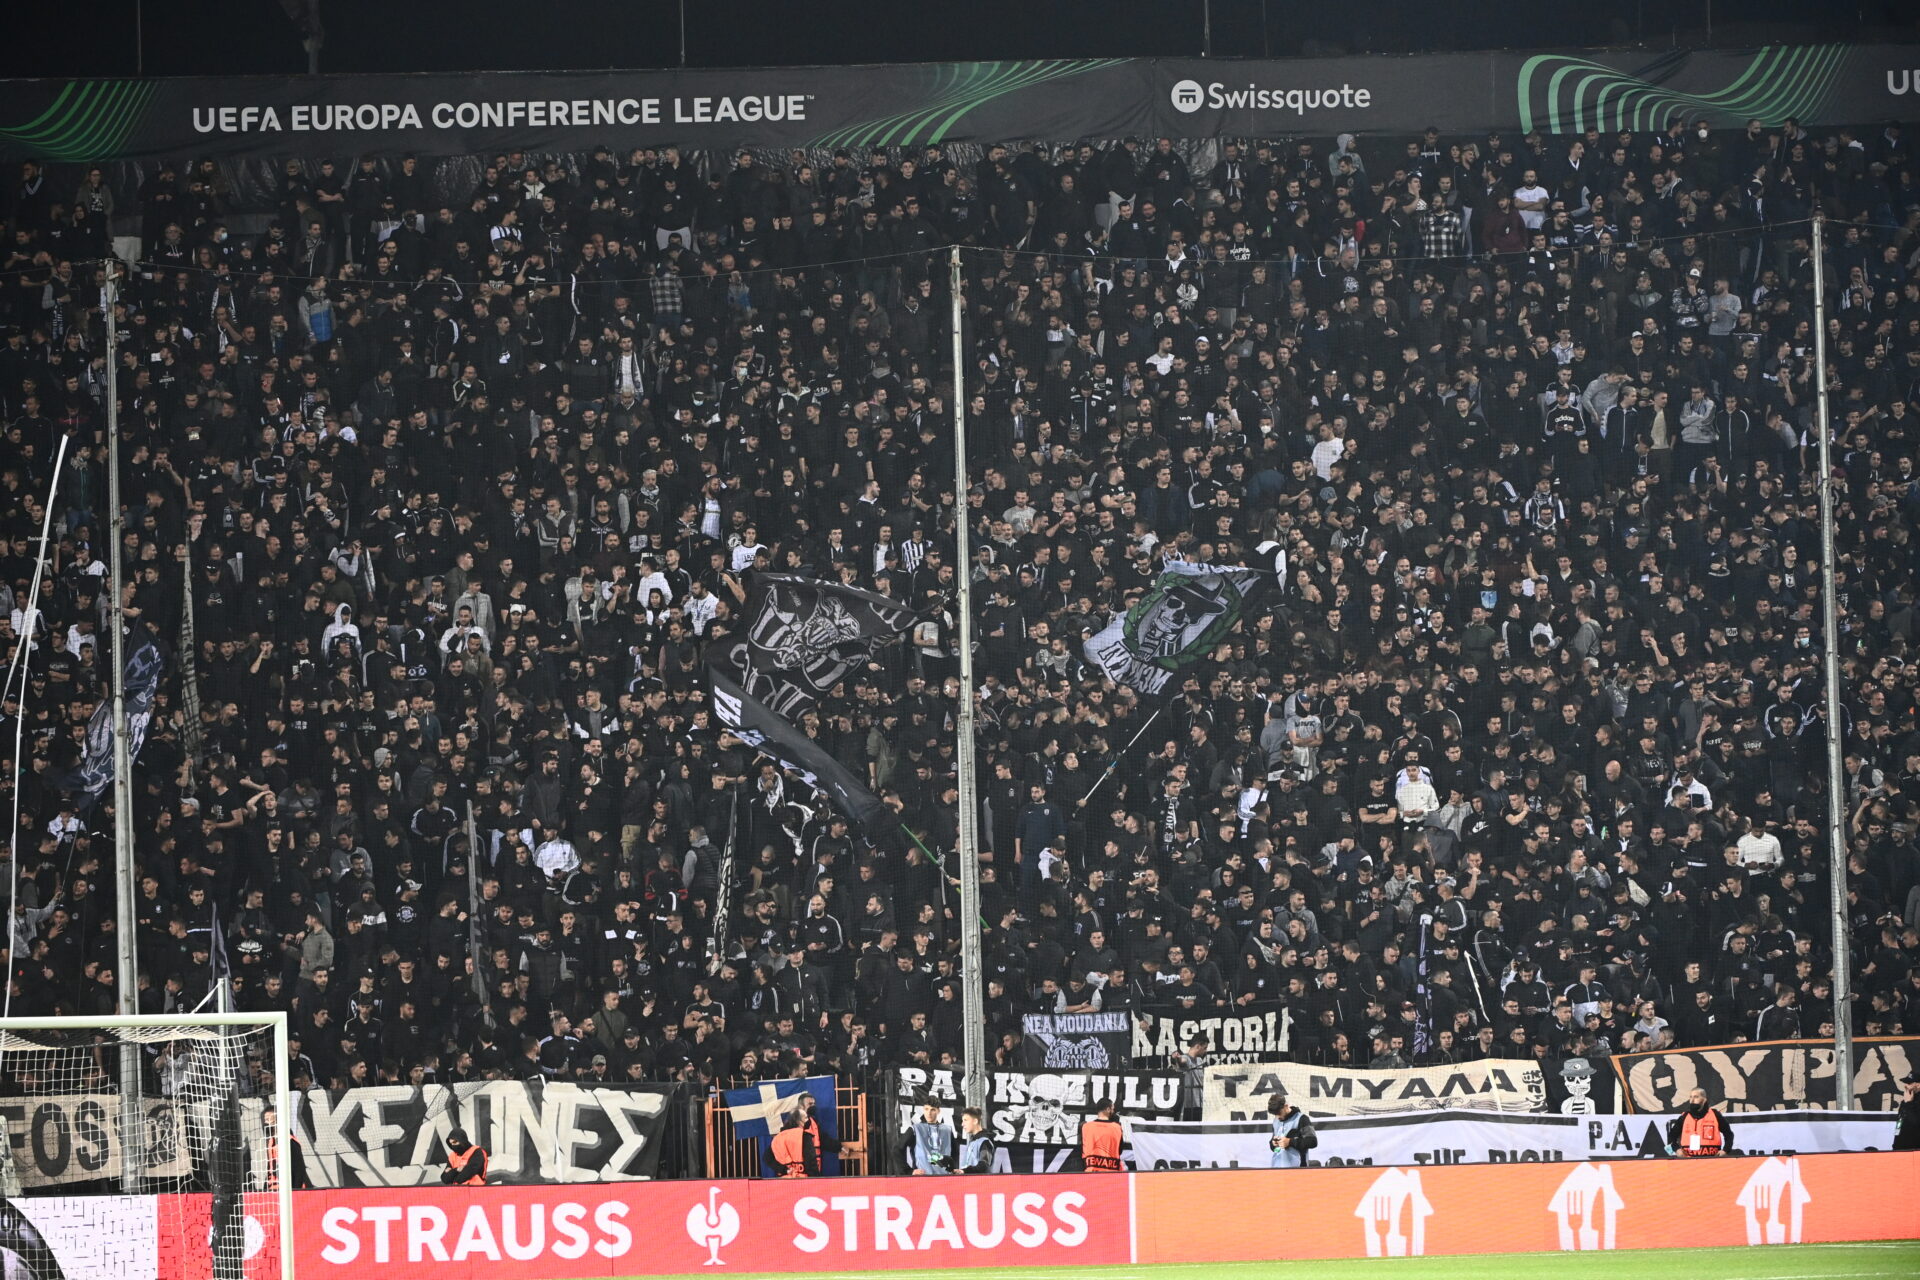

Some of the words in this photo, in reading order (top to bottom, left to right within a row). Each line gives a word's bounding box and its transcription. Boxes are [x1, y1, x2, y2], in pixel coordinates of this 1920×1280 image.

[1208, 82, 1371, 115] Swissquote
[1887, 69, 1920, 95] UE
[193, 106, 282, 133] UEFA
[291, 103, 423, 131] EUROPA
[431, 98, 660, 129] CONFERENCE
[1024, 1015, 1051, 1034] NEA
[1055, 1011, 1128, 1033] MOUDANIA
[1060, 1075, 1180, 1109] ZULU
[1086, 1157, 1118, 1169] TEWARD
[320, 1200, 633, 1265] STRAUSS
[792, 1190, 1089, 1253] STRAUSS
